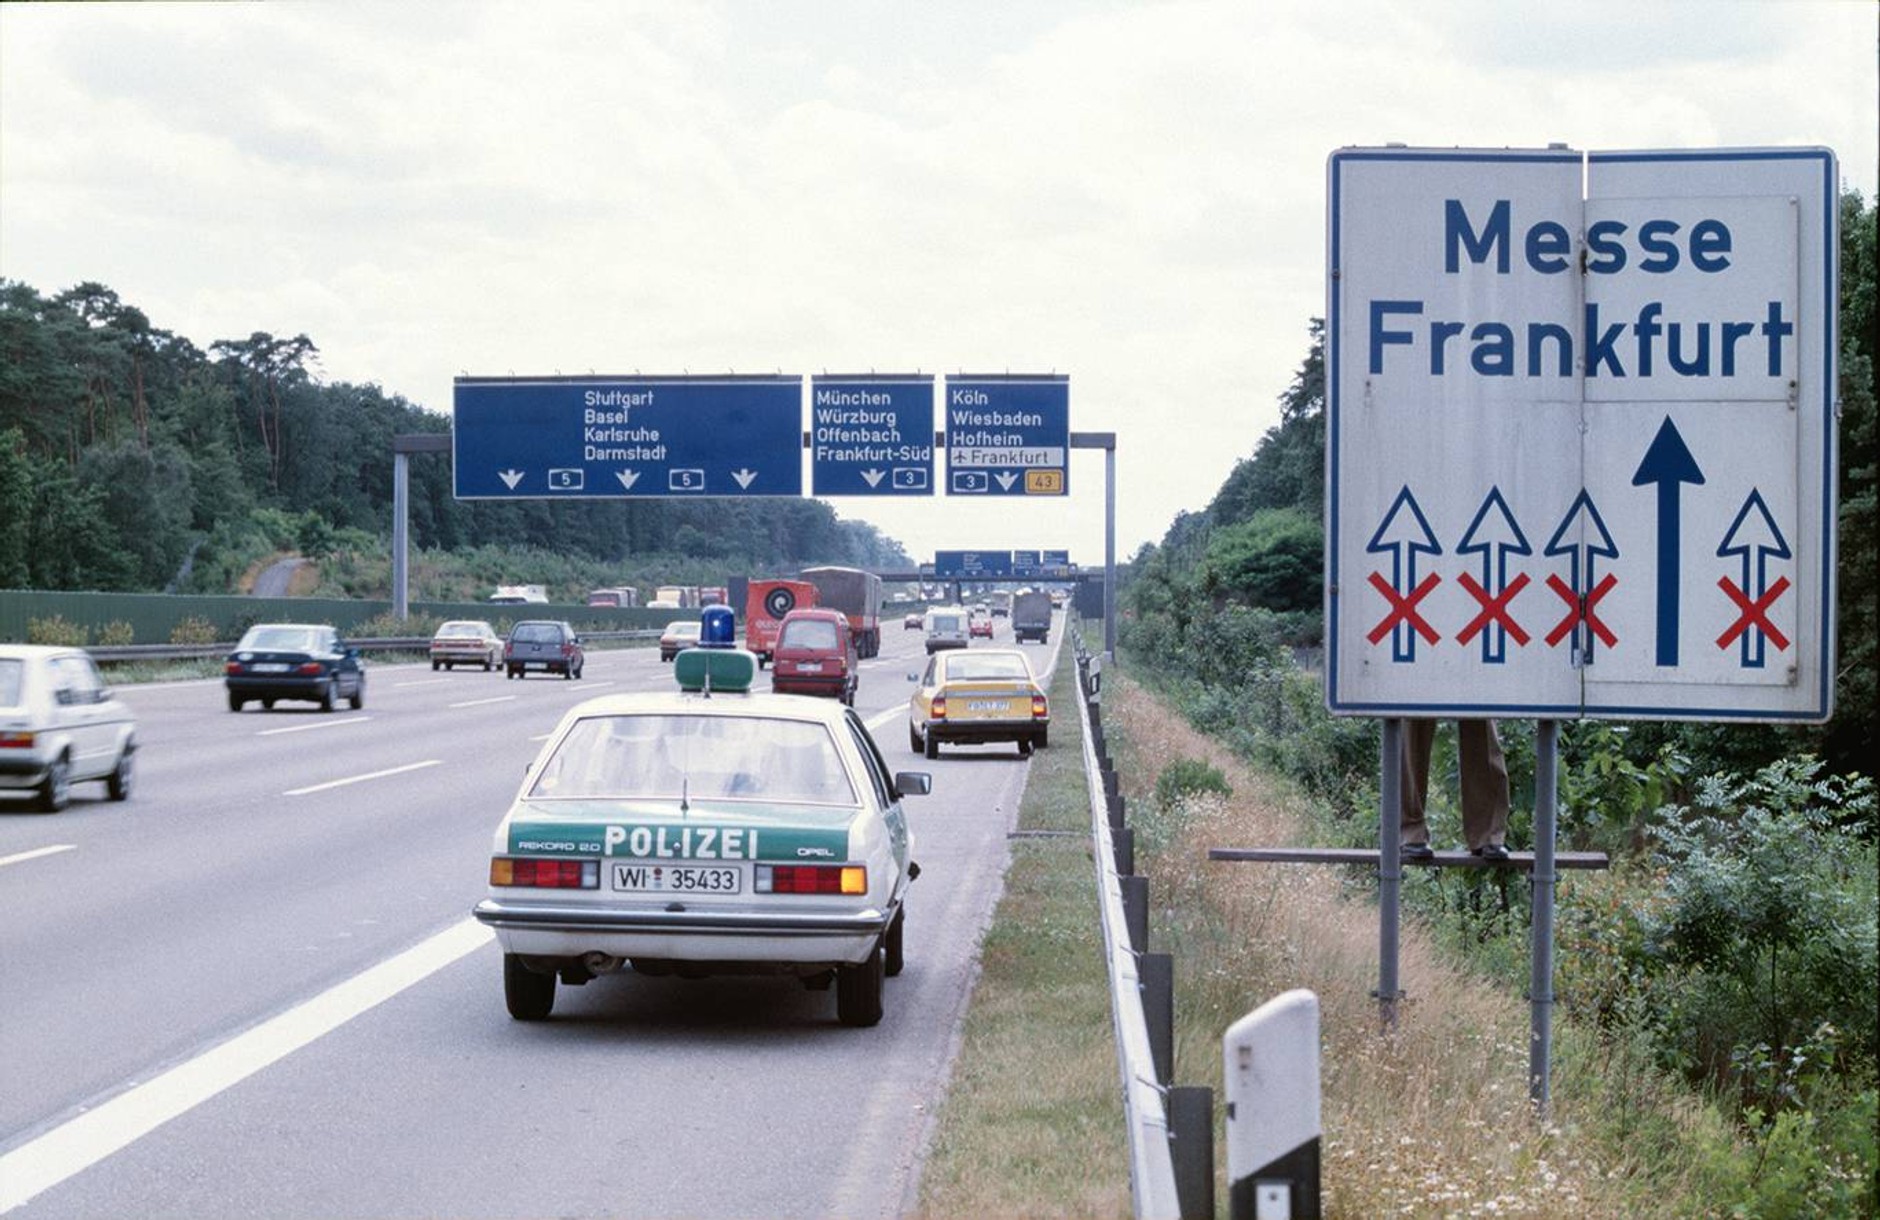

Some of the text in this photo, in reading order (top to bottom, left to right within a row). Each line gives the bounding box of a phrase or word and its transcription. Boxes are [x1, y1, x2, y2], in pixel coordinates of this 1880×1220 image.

[1444, 199, 1733, 275] Messe
[1369, 300, 1793, 378] Frankfurt
[584, 390, 654, 408] Stuttgart
[816, 390, 891, 406] München
[952, 390, 989, 405] Köln
[584, 408, 629, 424] Basel
[816, 408, 897, 427] Würzburg
[952, 411, 1042, 427] Wiesbaden
[584, 427, 660, 442] Karlsruhe
[816, 427, 901, 443] Offenbach
[952, 431, 1023, 446] Hofheim
[584, 445, 667, 461] Darmstadt
[816, 445, 931, 462] Frankfurt-Süd
[971, 450, 1048, 464] Frankfurt
[561, 473, 570, 486] 5
[682, 473, 691, 486] 5
[905, 471, 914, 484] 3
[966, 476, 975, 488] 3
[1034, 475, 1053, 488] 43
[518, 840, 575, 852] REKORD
[604, 825, 759, 860] POLIZEI
[796, 847, 835, 857] OPEL
[670, 868, 735, 890] 35433
